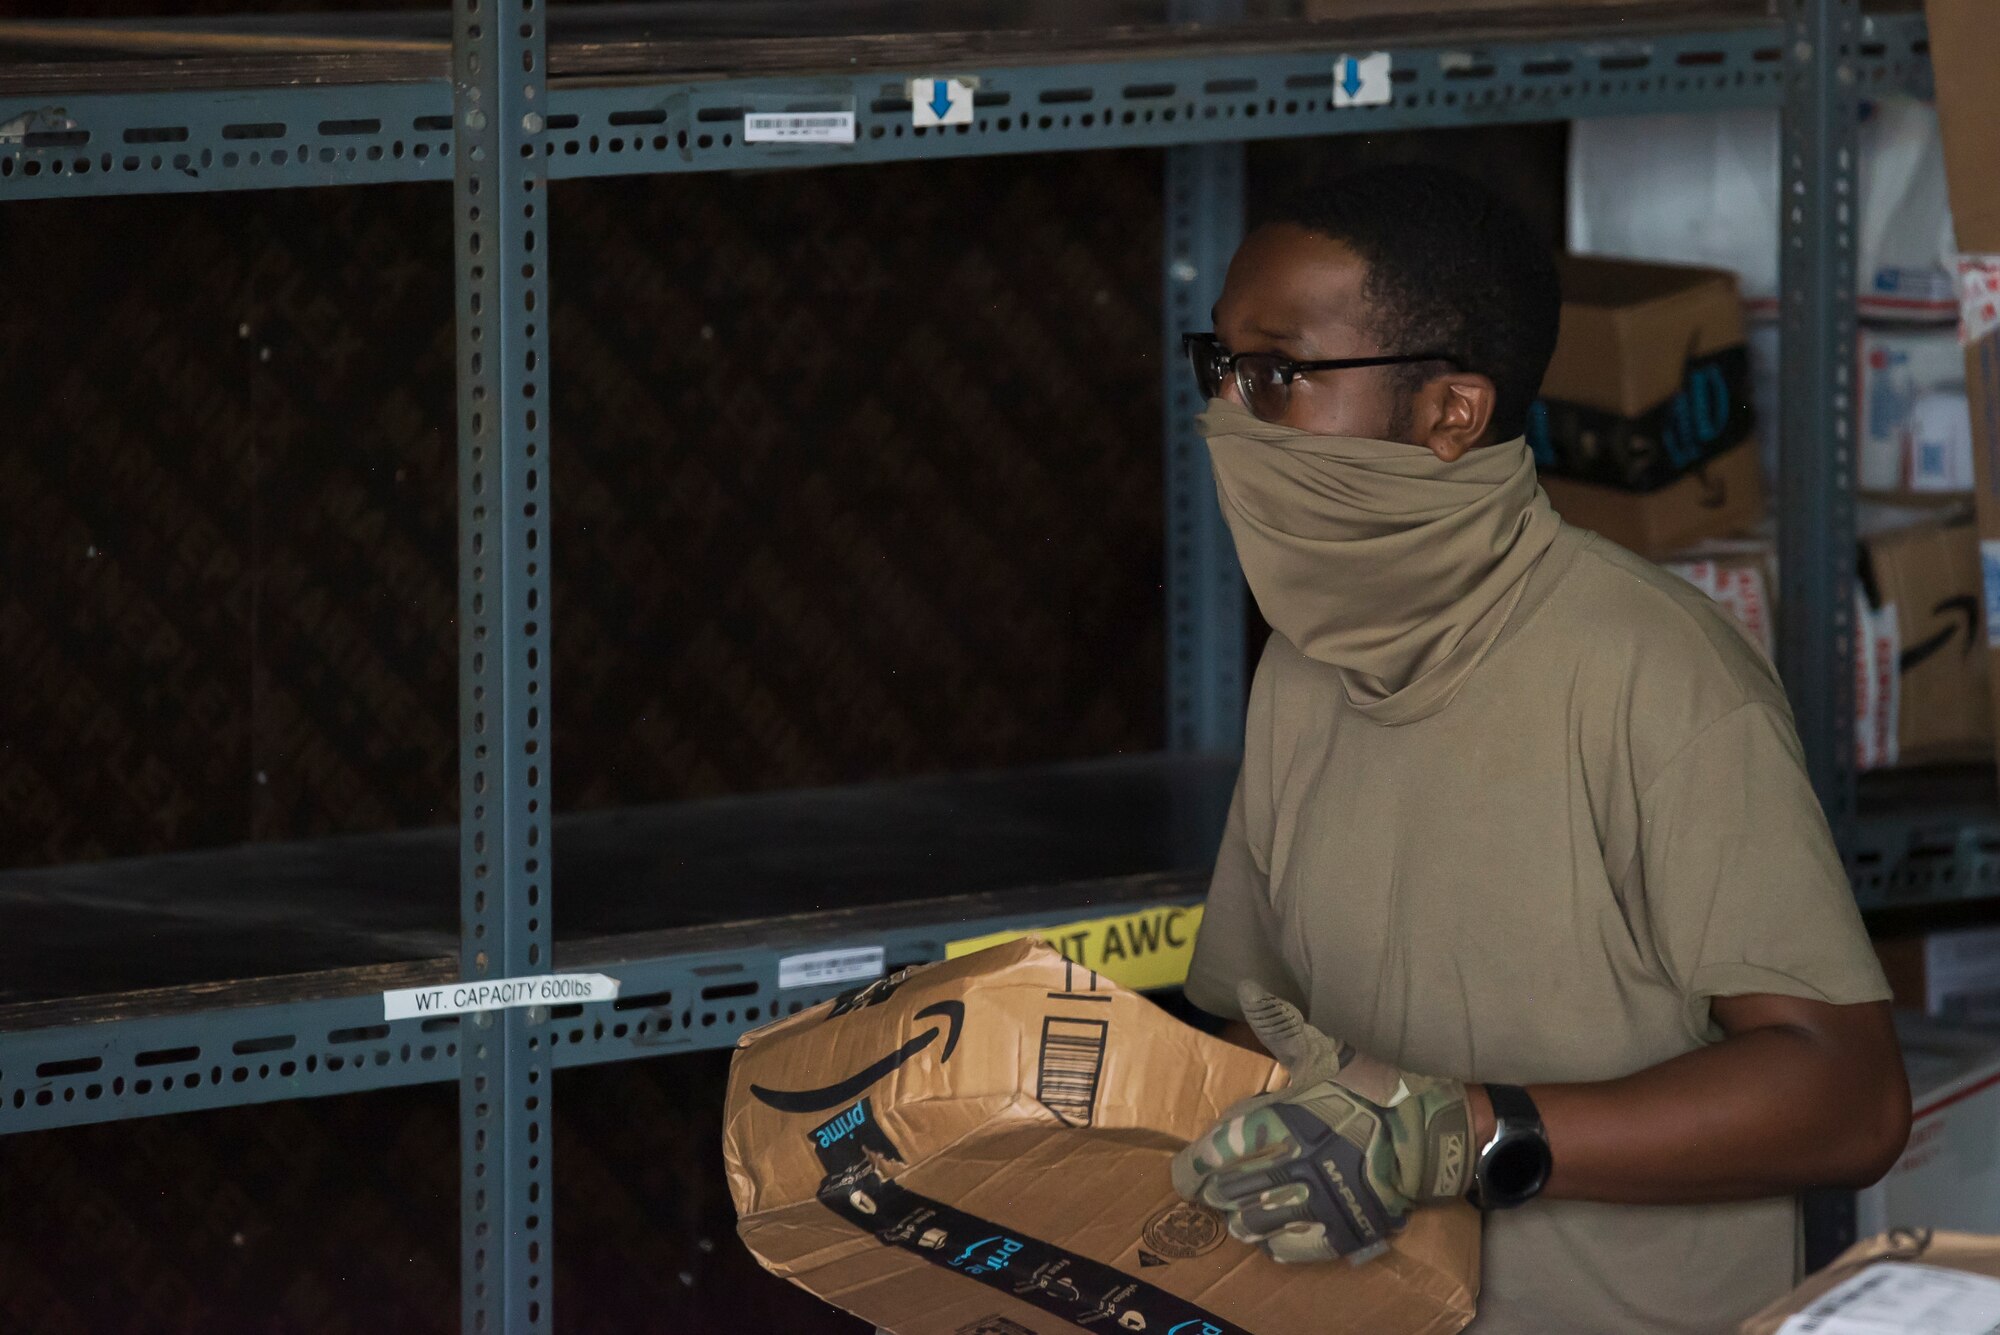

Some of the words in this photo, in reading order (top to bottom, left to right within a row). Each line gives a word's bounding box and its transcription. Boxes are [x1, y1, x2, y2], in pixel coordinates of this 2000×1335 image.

[414, 991, 447, 1011] WT.
[454, 981, 538, 1008] CAPACITY
[541, 979, 592, 999] 600lbs
[816, 1099, 866, 1148] prime
